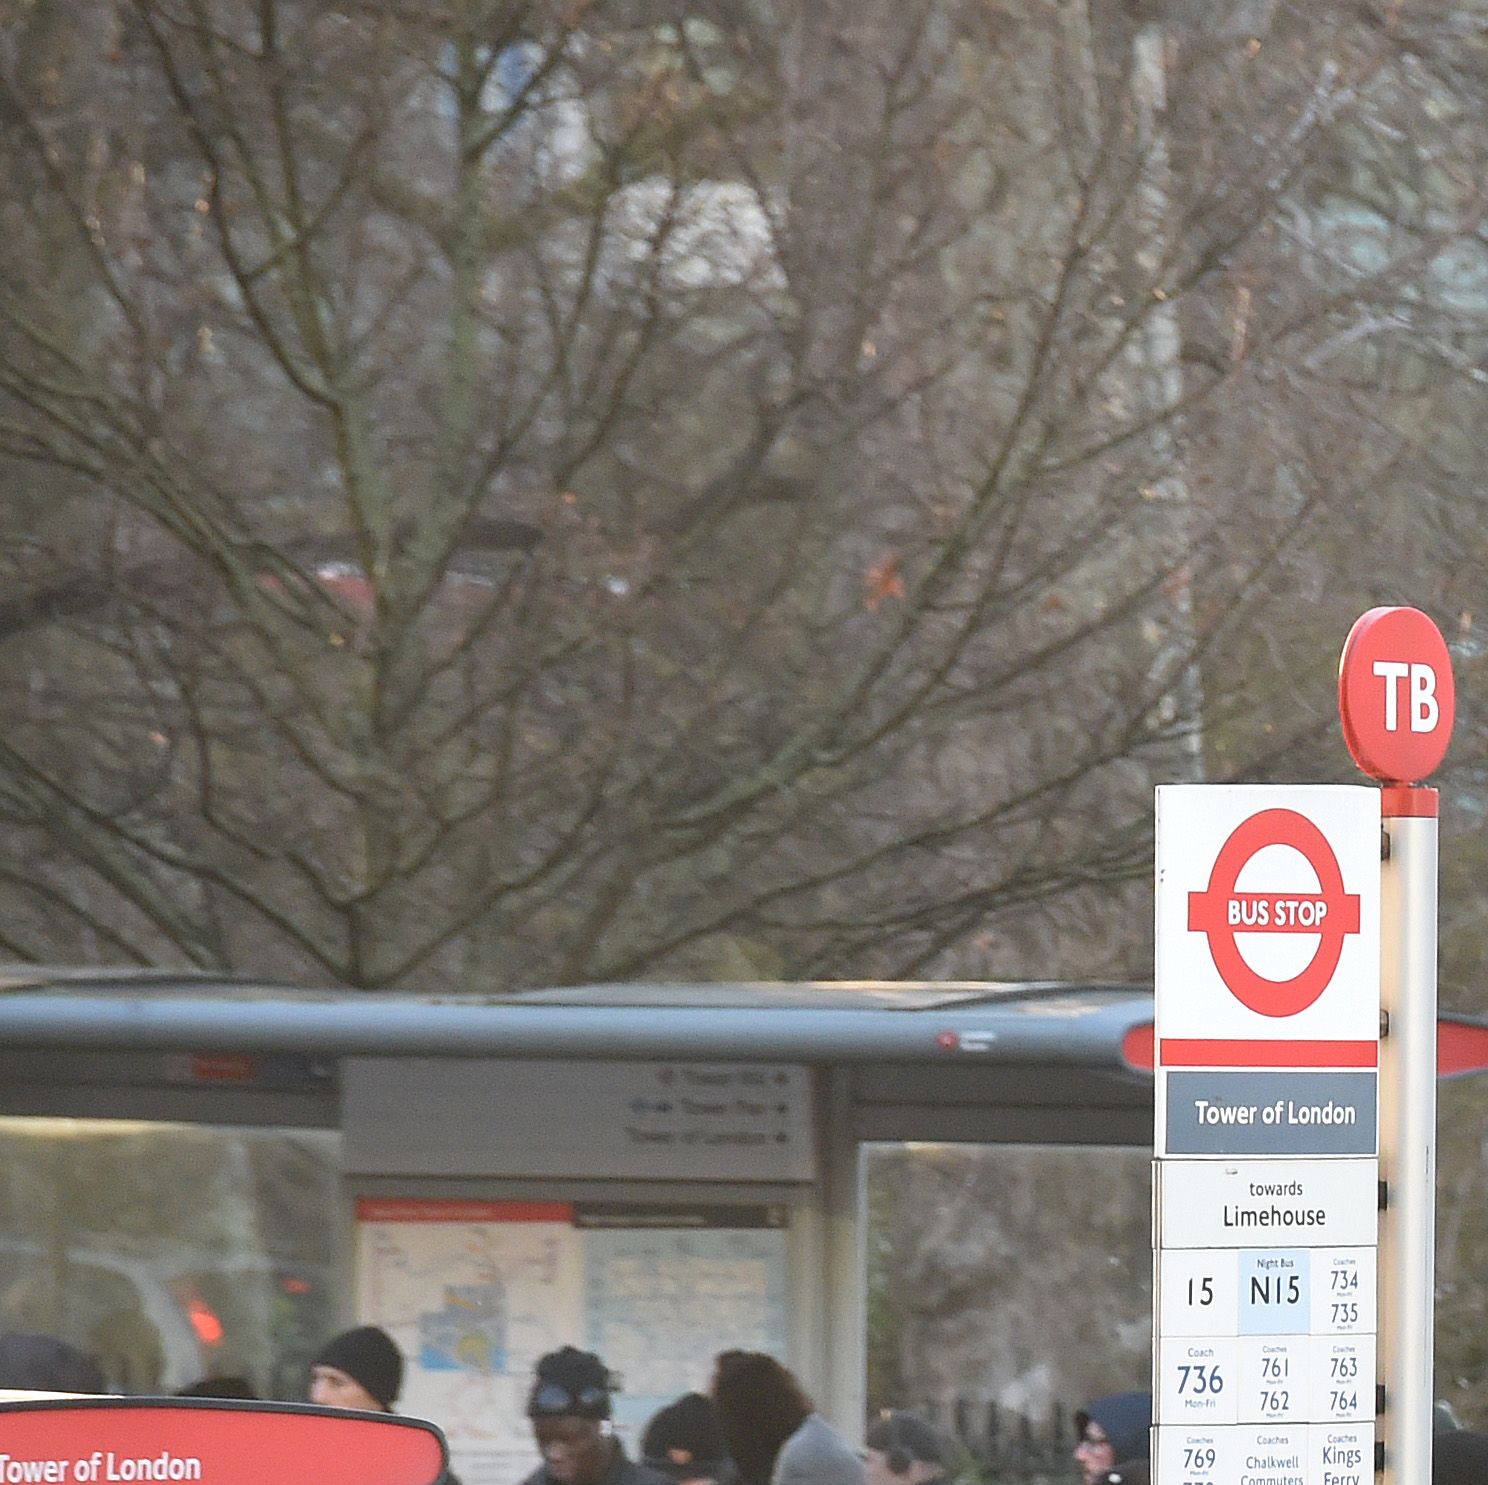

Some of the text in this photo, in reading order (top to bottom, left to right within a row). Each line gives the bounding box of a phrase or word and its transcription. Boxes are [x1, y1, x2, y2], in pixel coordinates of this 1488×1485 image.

[1373, 661, 1440, 733] TB
[1228, 899, 1328, 927] BUS STOP
[1195, 1100, 1356, 1125] Tower of London
[1250, 1181, 1303, 1196] towards
[1224, 1205, 1326, 1227] Limehouse
[1257, 1258, 1294, 1270] Night Bus
[1251, 1275, 1300, 1305] N15
[1330, 1270, 1358, 1290] 734
[1188, 1277, 1213, 1306] 15
[1331, 1303, 1358, 1323] 735
[1188, 1348, 1214, 1358] Coach
[1261, 1358, 1289, 1378] 761
[1330, 1357, 1357, 1378] 763
[1177, 1365, 1224, 1394] 736
[1184, 1398, 1216, 1409] Mon-Fri
[1260, 1391, 1289, 1411] 762
[1330, 1391, 1357, 1411] 764
[1257, 1435, 1288, 1445] Coaches
[1327, 1434, 1357, 1444] Coaches
[1183, 1449, 1216, 1469] 769
[1246, 1456, 1299, 1469] Chalkwell
[1322, 1446, 1361, 1469] Kings
[0, 1452, 201, 1484] Tower of London
